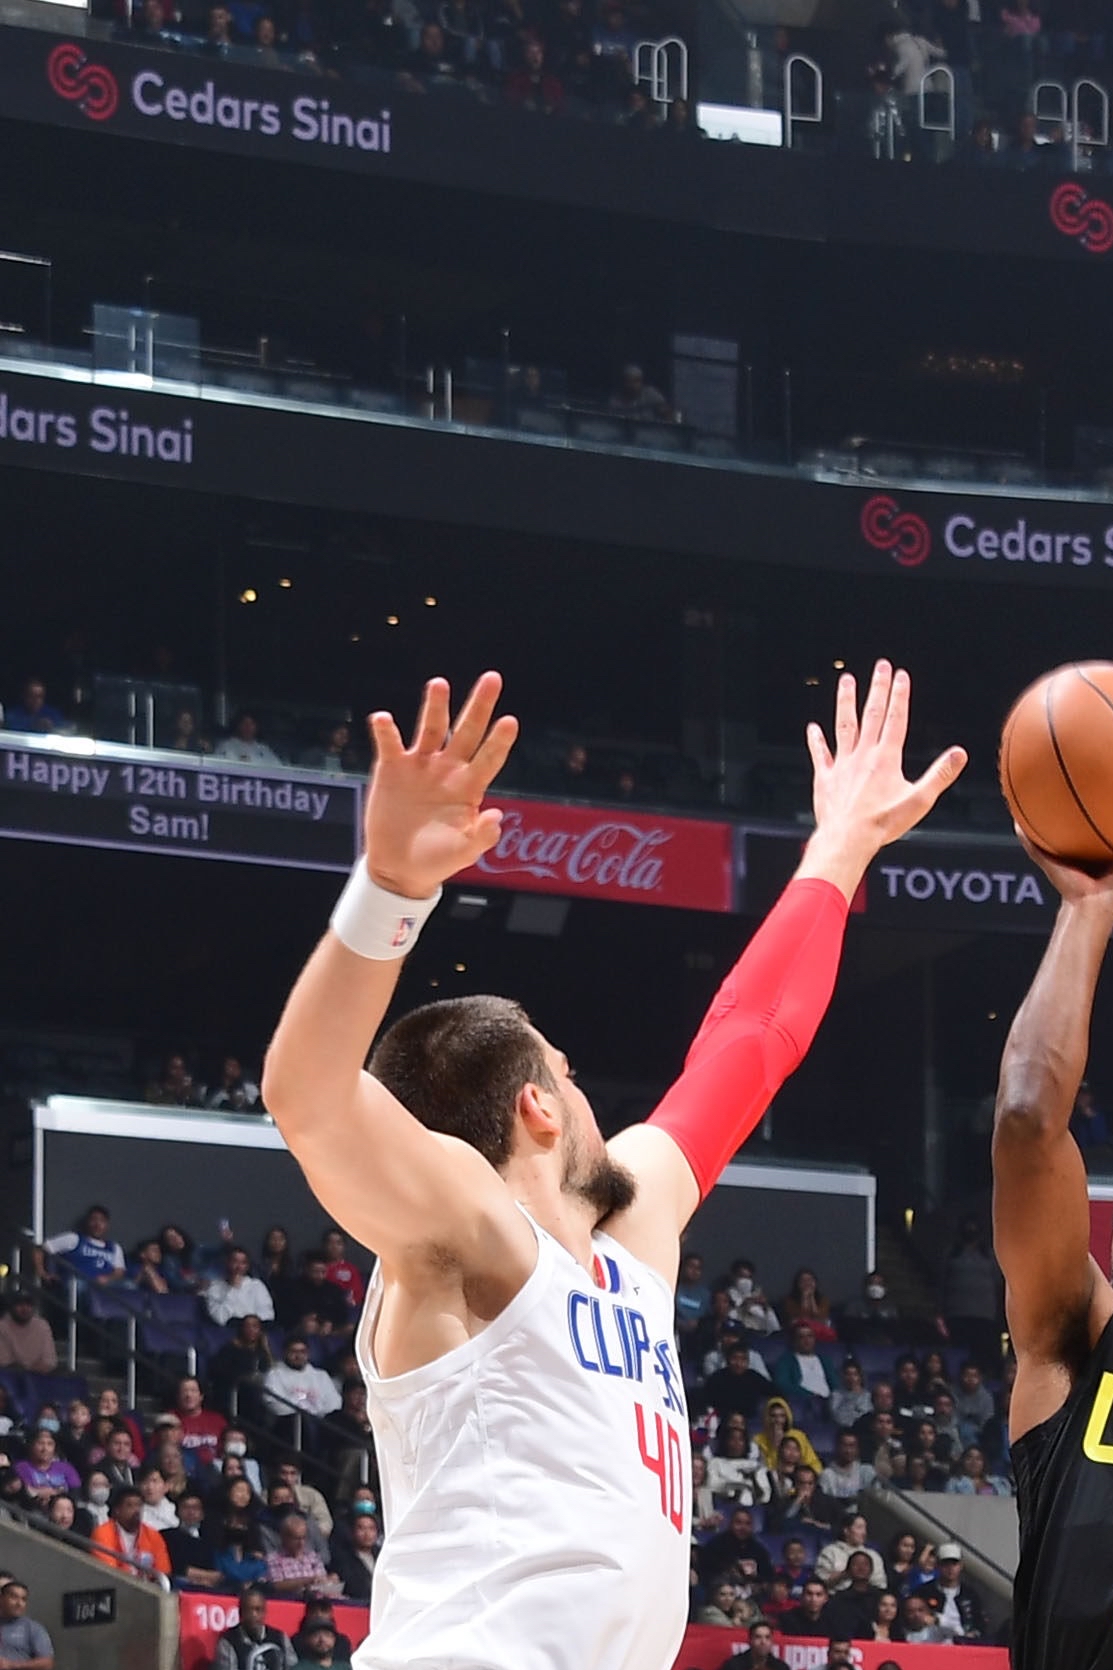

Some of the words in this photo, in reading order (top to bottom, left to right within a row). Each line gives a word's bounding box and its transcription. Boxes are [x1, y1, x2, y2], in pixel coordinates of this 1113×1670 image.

[132, 71, 281, 135] Cedars
[291, 98, 391, 153] Sinai
[90, 408, 193, 463] Sinai
[944, 516, 1093, 565] Cedars
[6, 753, 110, 796] Happy
[120, 766, 186, 799] 12th
[199, 774, 330, 821] Birthday
[128, 805, 209, 841] Sam!
[880, 867, 1044, 905] TOYOTA
[634, 1401, 684, 1535] 40
[196, 1604, 241, 1632] 104
